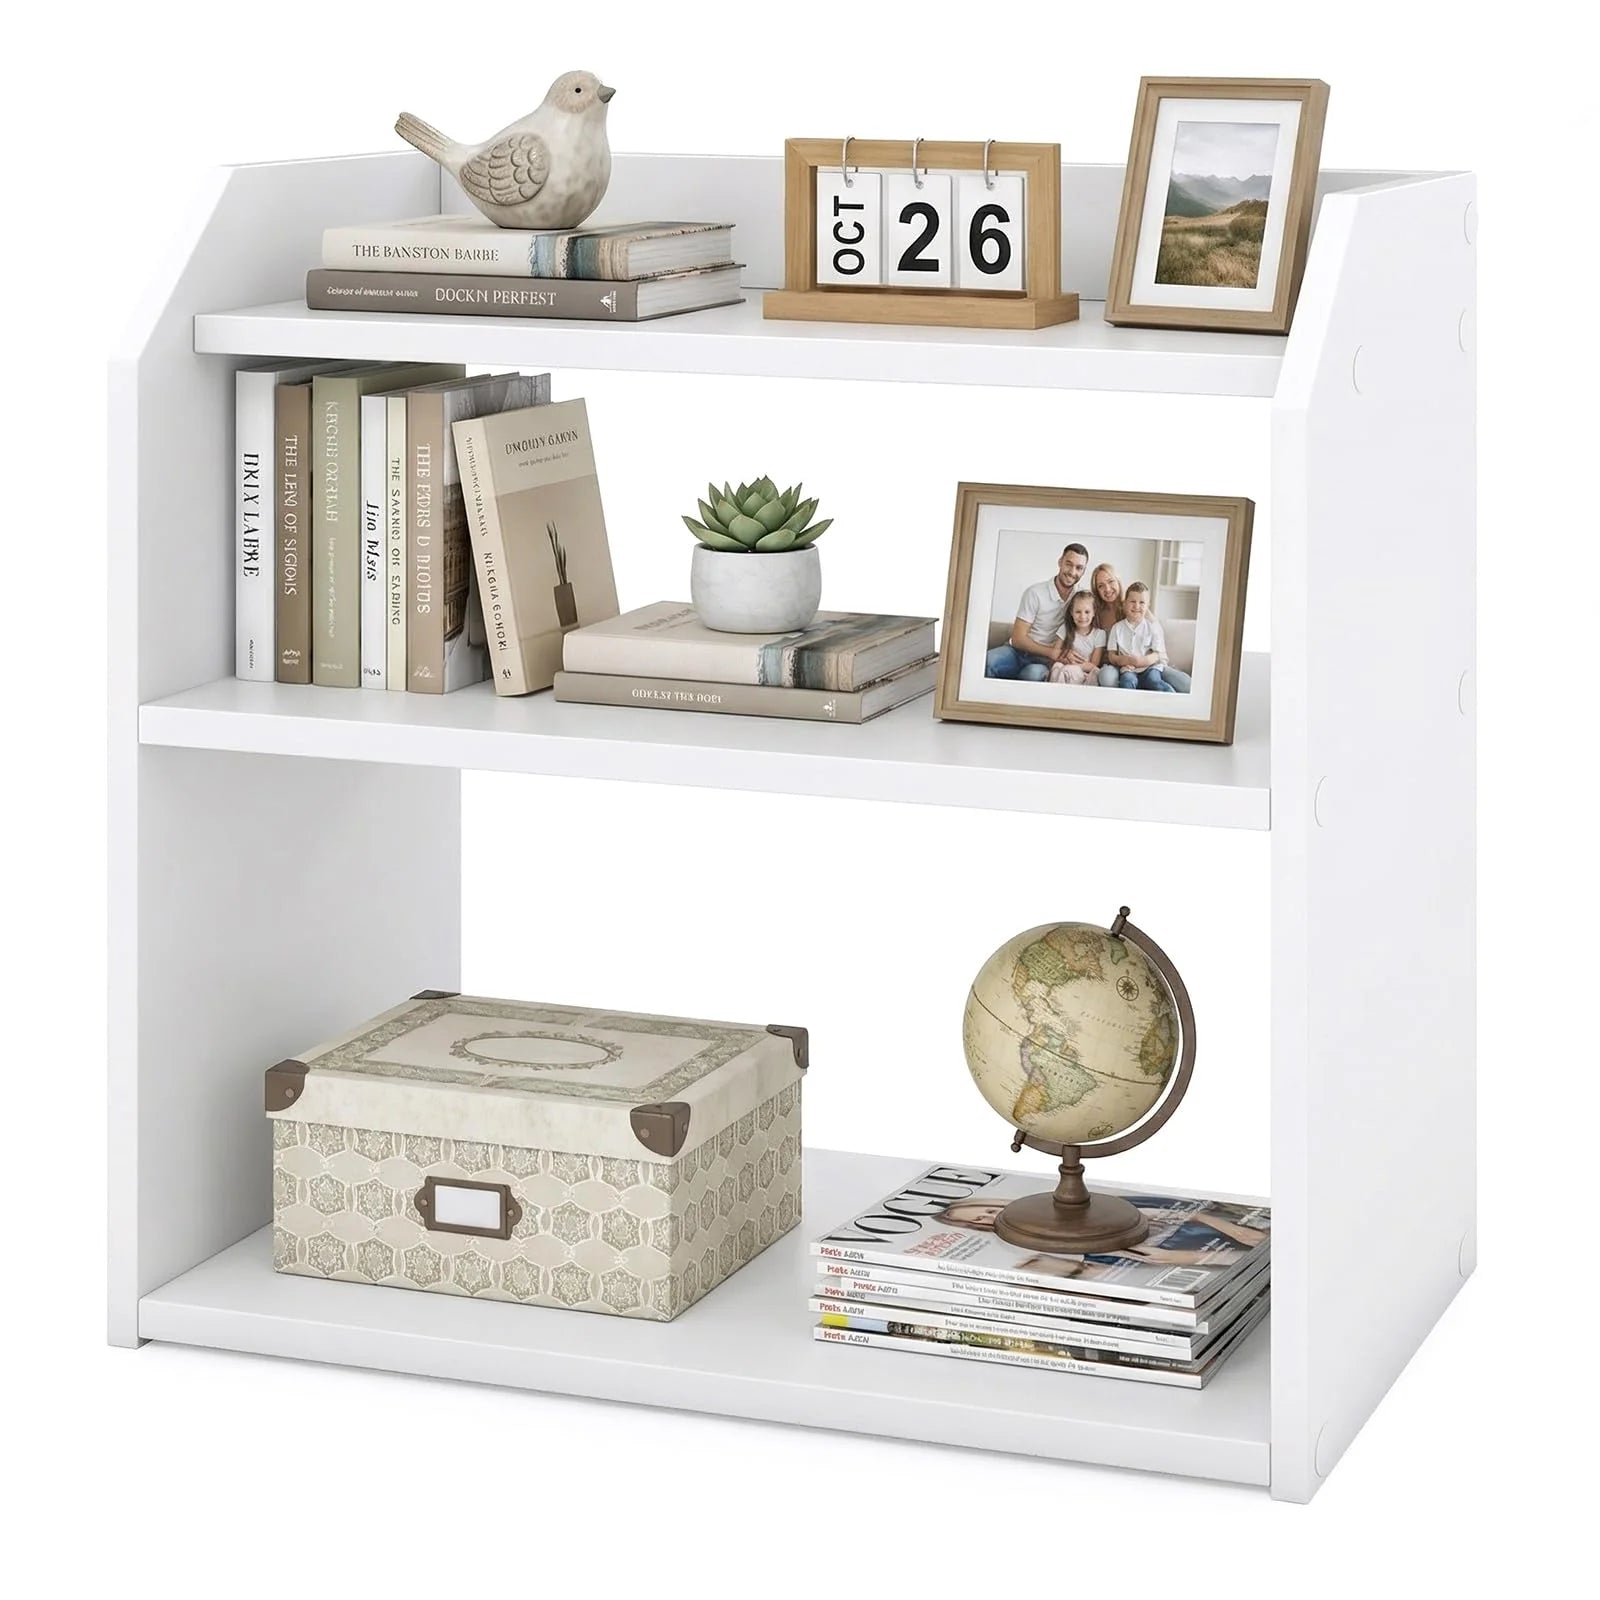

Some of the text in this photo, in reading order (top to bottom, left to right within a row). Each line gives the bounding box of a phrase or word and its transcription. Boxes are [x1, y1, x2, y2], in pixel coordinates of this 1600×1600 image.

[352, 245, 380, 257] THE
[833, 195, 865, 275] OCT
[897, 201, 1011, 275] 2 6
[284, 435, 298, 467] THE
[416, 443, 431, 478] THE
[391, 457, 401, 481] THE
[284, 513, 298, 534] OF
[820, 1166, 1001, 1244] VOGUE
